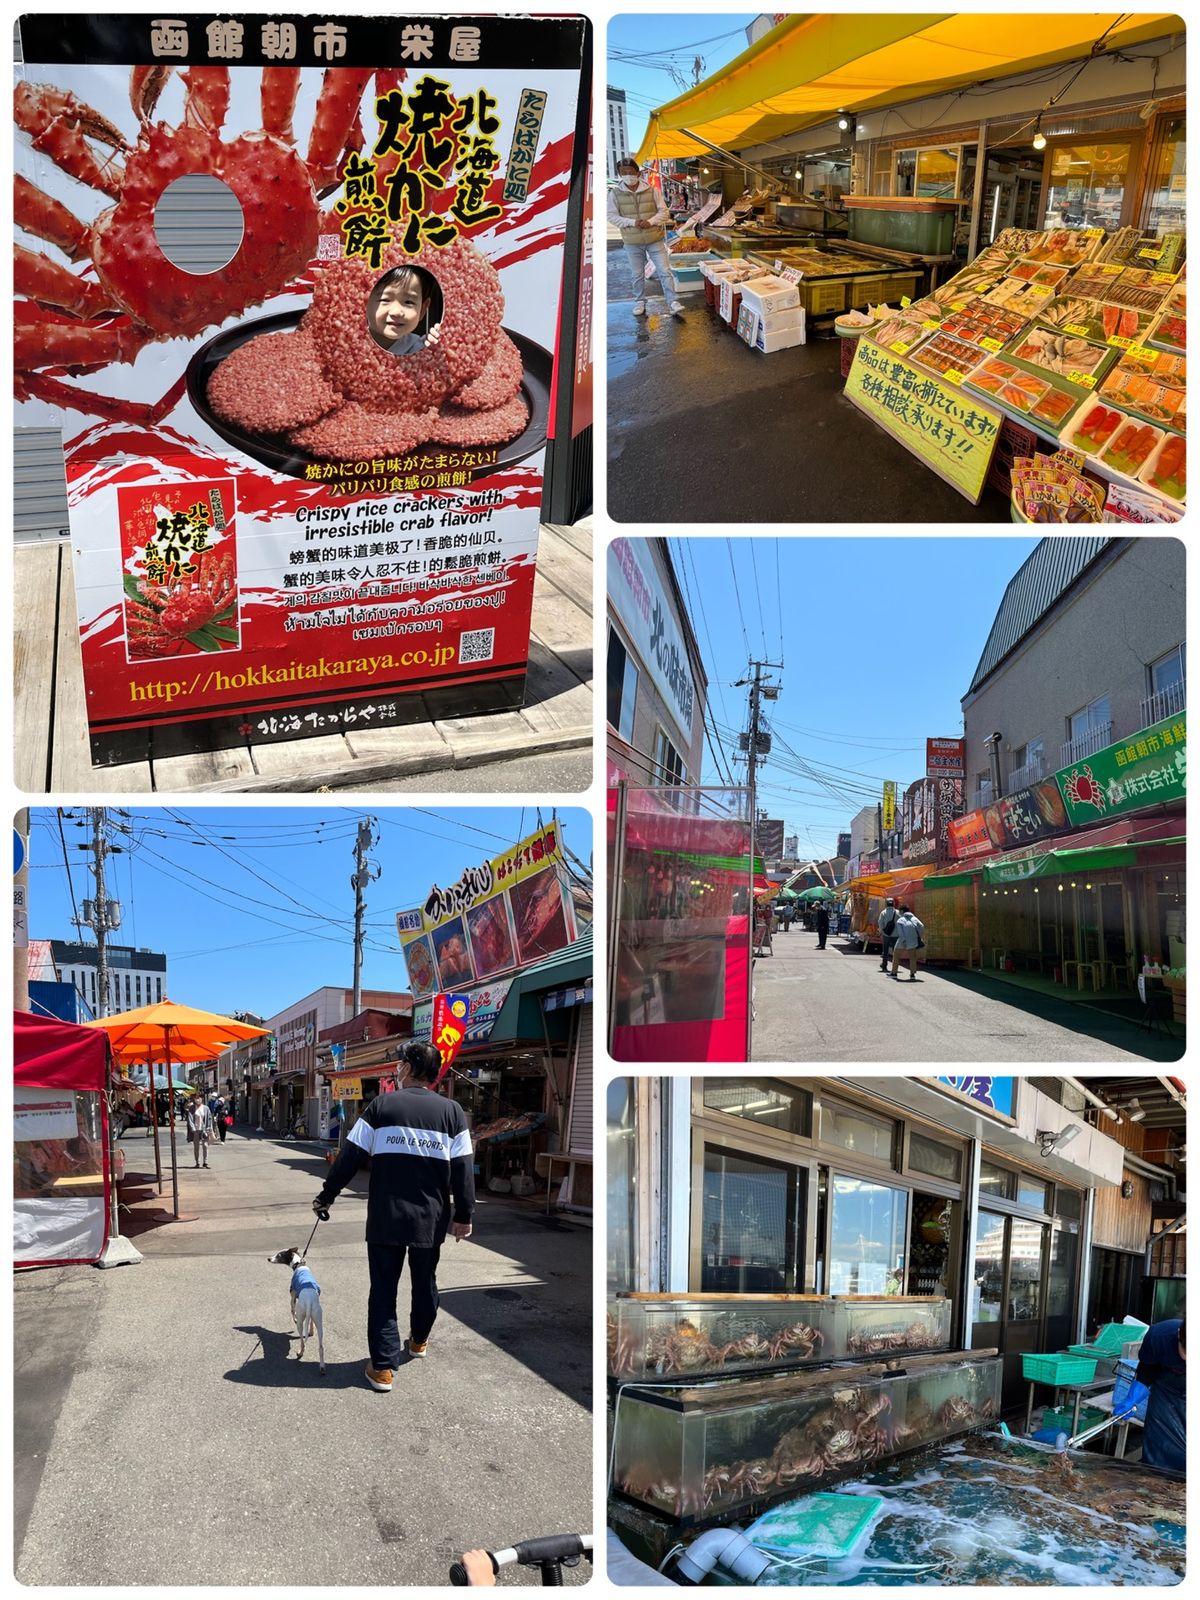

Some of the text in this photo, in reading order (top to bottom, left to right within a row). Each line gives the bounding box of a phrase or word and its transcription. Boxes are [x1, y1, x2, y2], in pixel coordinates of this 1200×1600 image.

[151, 19, 481, 61] 函館朝市 栄屋
[373, 76, 460, 255] 焼かに
[450, 89, 502, 226] 北海道
[335, 152, 392, 269] 煎餅
[305, 450, 497, 481] 焼かにの旨味がたまらない!
[330, 471, 473, 496] パリパリ食感の煎餅!
[295, 490, 503, 523] Crispy rice crackers with
[305, 509, 493, 541] irresistible crab flavor!
[156, 511, 198, 577] 焼かに
[284, 593, 308, 608] 게의
[309, 587, 355, 606] 감칠맛이
[357, 581, 417, 600] 끝내줍니다!
[419, 574, 473, 592] 바삭바삭한
[129, 642, 455, 702] http://hokkaitakaraya.co.jp
[386, 1135, 444, 1151] POUR LE SPORTS
